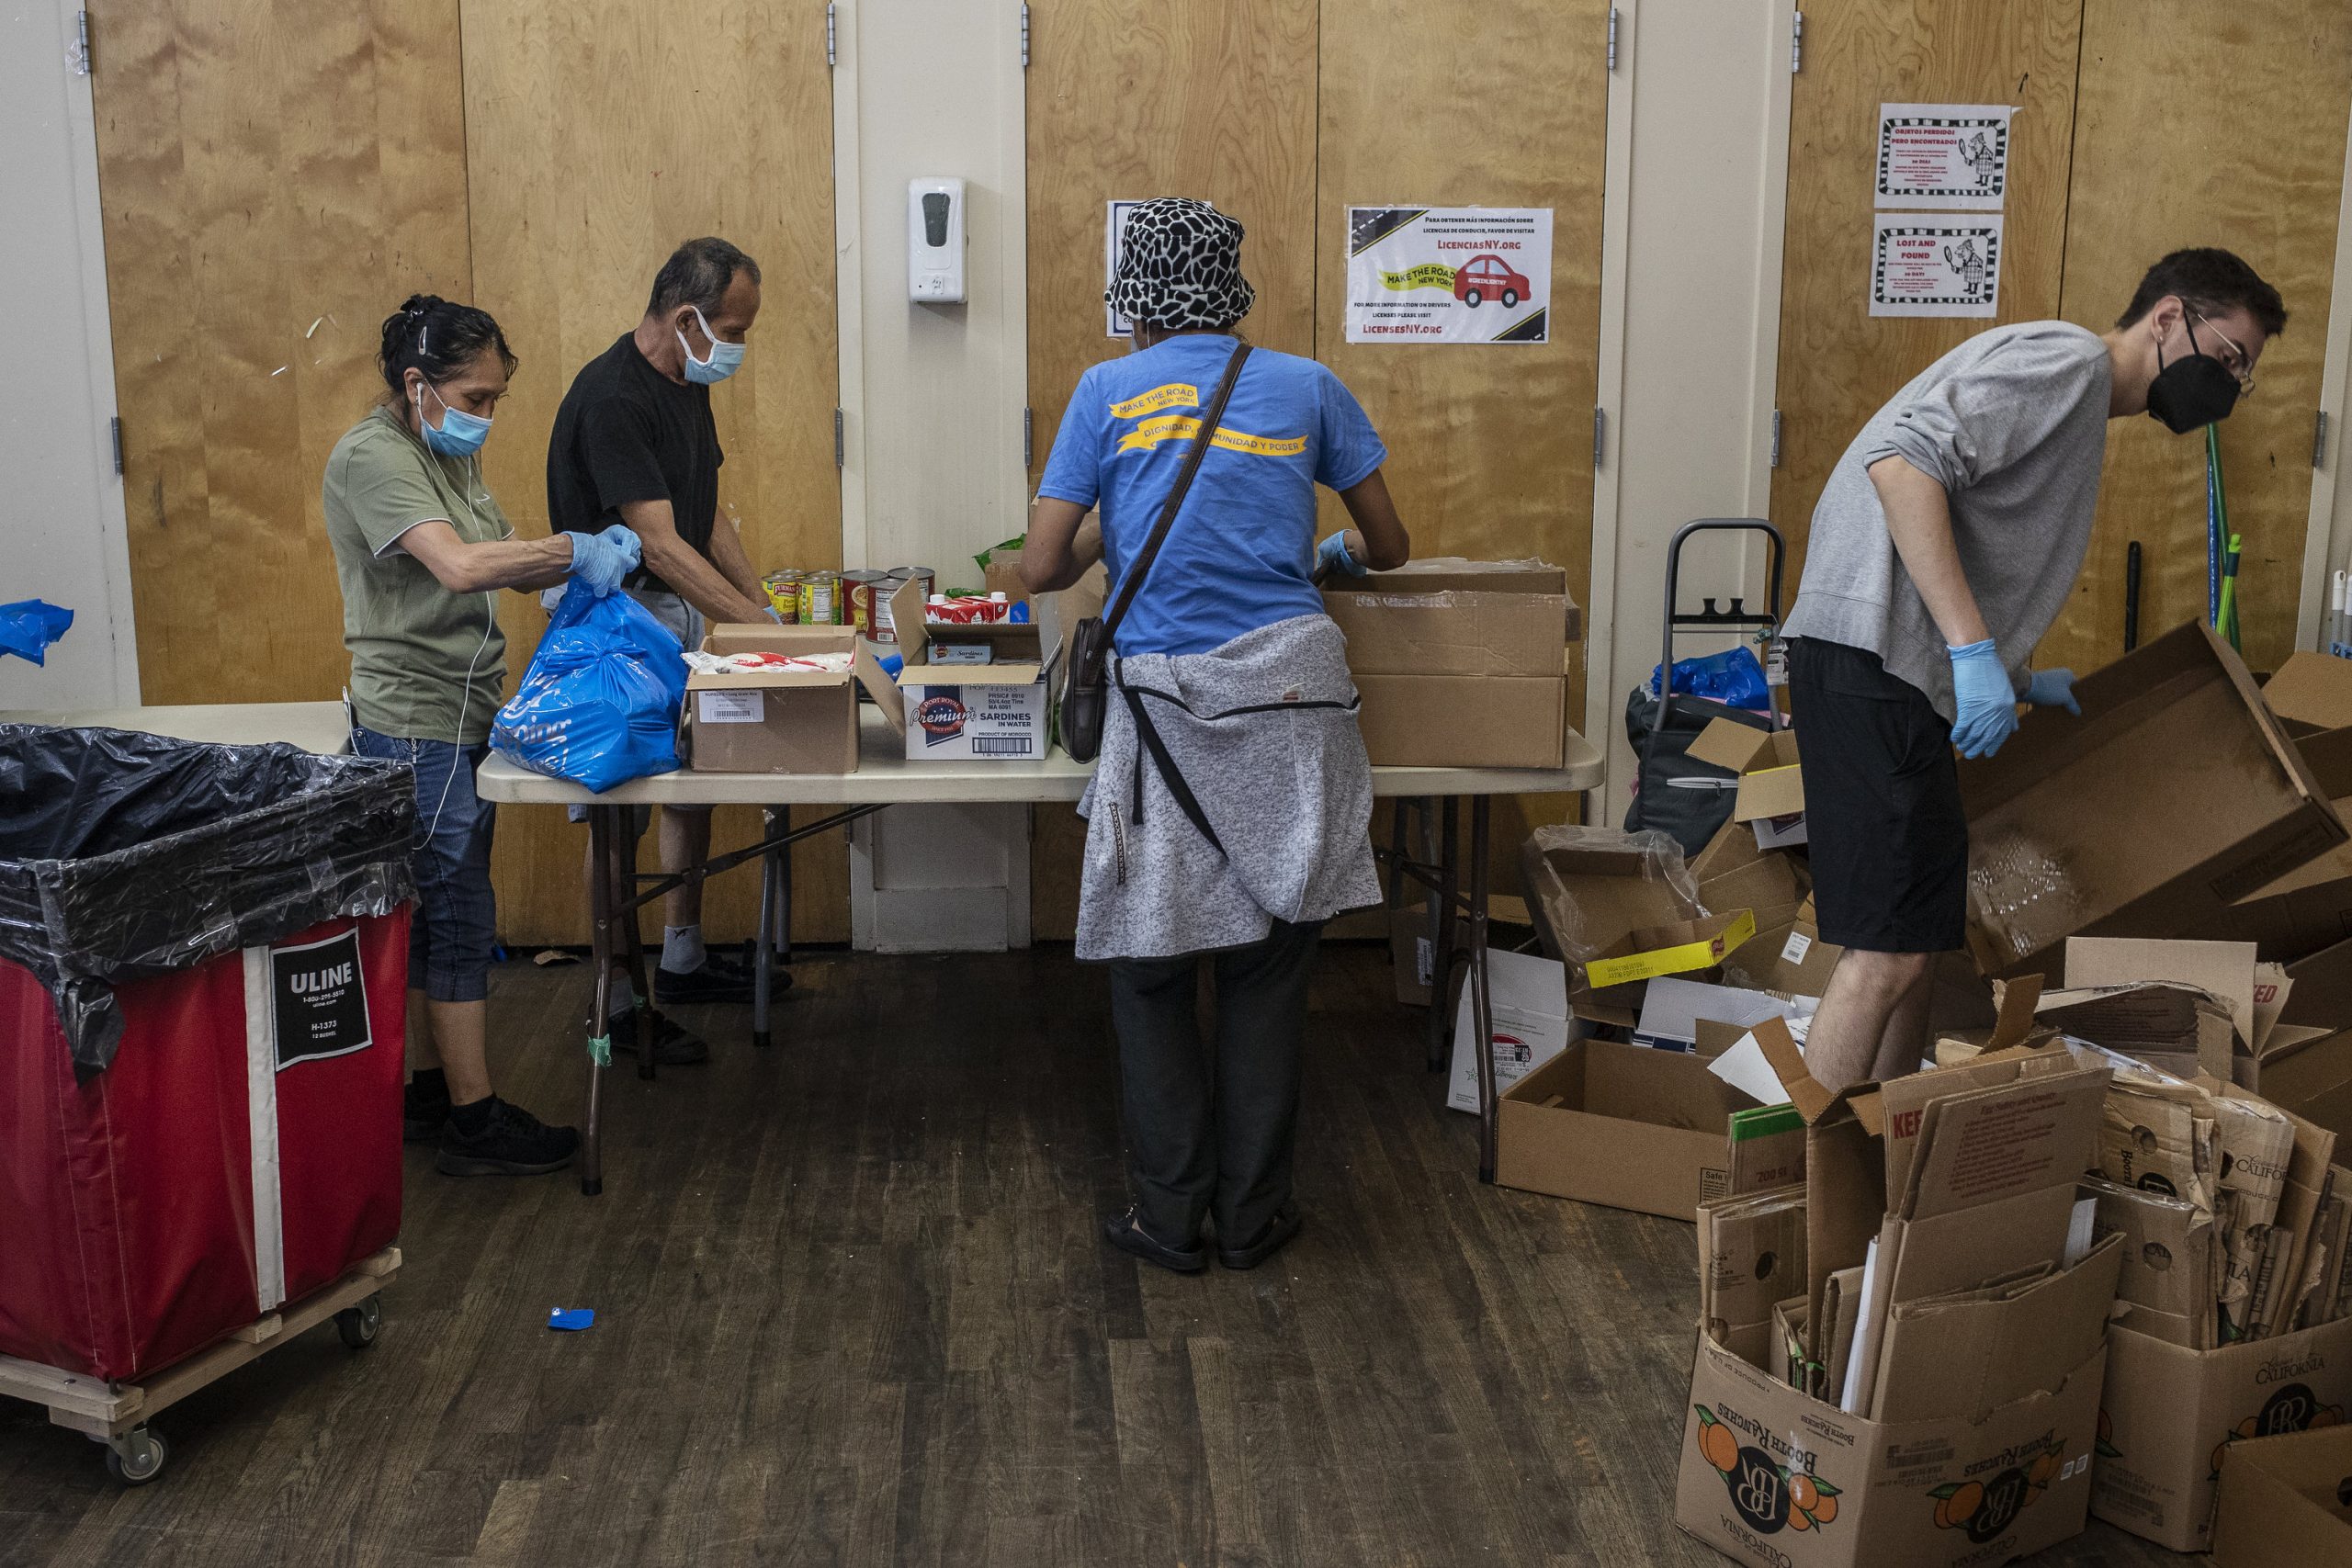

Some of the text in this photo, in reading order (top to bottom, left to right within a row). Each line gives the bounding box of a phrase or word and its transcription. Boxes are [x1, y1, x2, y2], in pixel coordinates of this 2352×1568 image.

[1387, 266, 1456, 284] MAKE THE ROAD
[1418, 276, 1453, 288] NEW YORK
[1118, 388, 1194, 413] MAKE THE ROAD
[1158, 396, 1195, 407] NEW YORK
[1143, 423, 1193, 437] DIGNIDAD,
[1260, 442, 1267, 450] Y
[1269, 442, 1299, 451] PODER
[922, 697, 959, 708] PORT ROYAL
[910, 707, 977, 727] Premium
[979, 713, 1032, 721] SARDINES
[290, 961, 353, 994] ULINE
[311, 1020, 337, 1031] H-1373
[1705, 1170, 1723, 1180] Safe
[2256, 1357, 2326, 1385] CALIFORNIA
[1717, 1402, 1771, 1450] RANCHES
[1770, 1436, 1818, 1476] BOOTH
